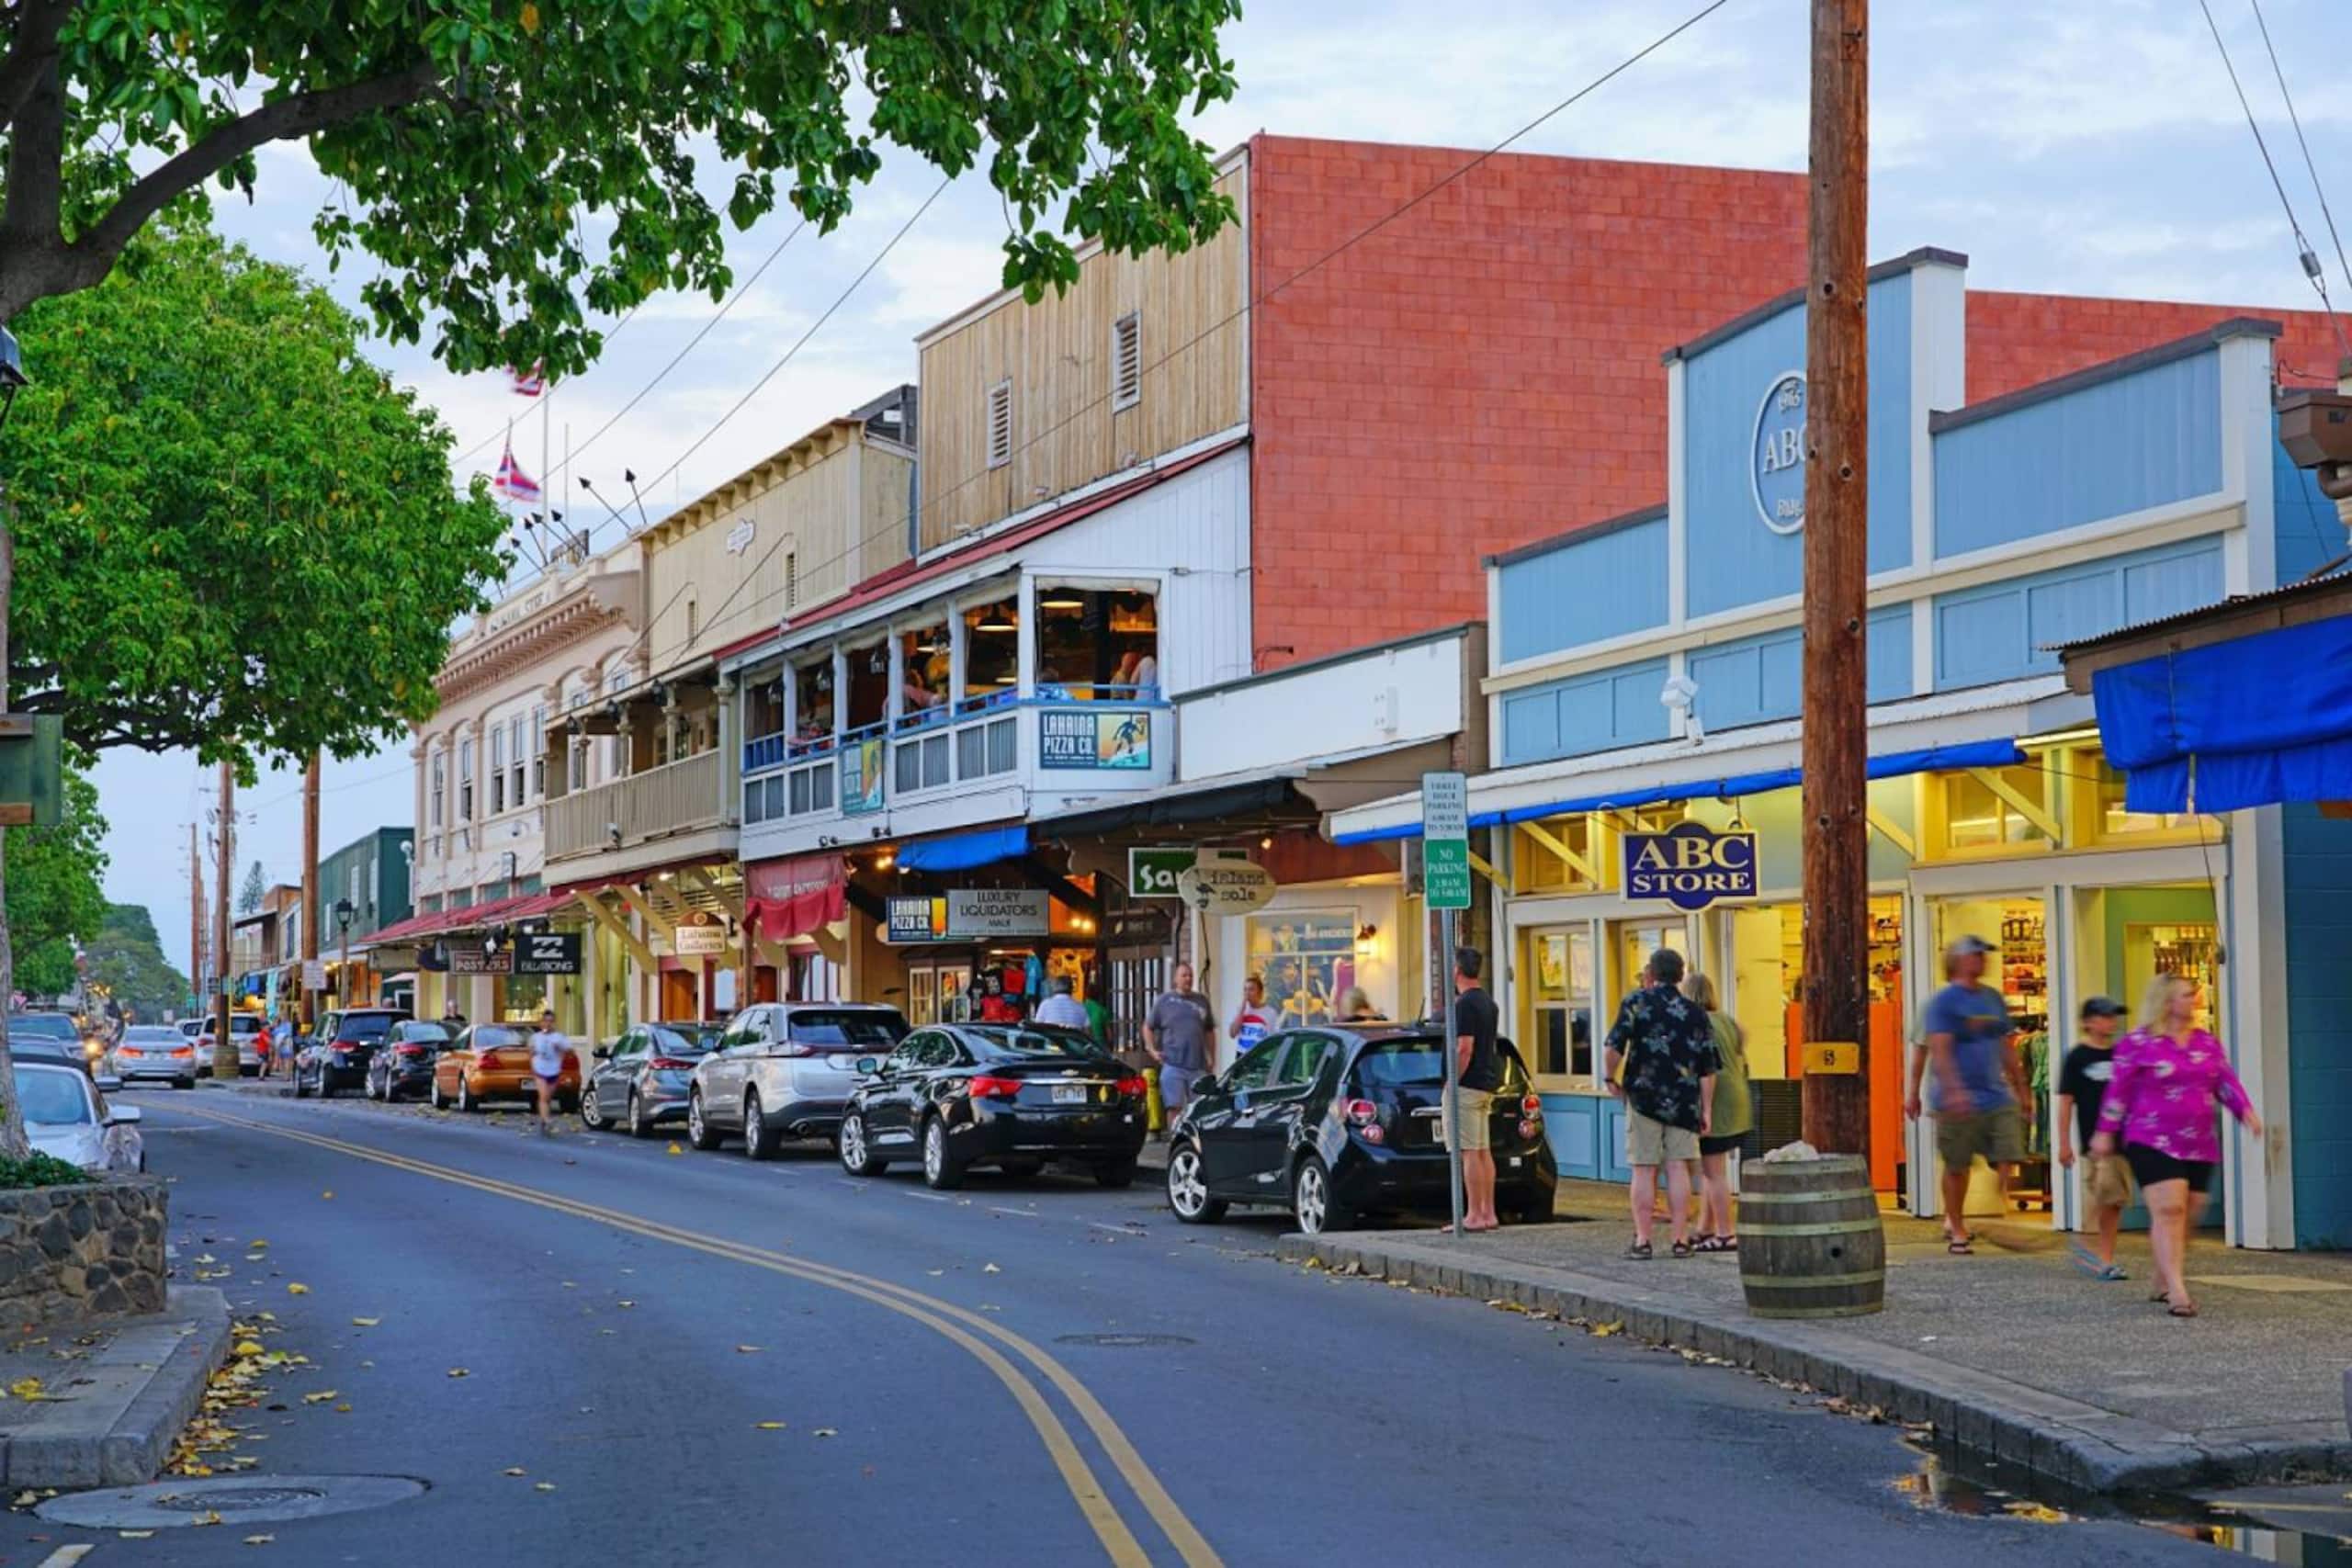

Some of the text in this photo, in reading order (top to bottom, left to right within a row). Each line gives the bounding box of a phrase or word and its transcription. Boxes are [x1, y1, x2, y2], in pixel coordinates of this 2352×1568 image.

[1044, 715, 1095, 736] LAHAINA
[1044, 737, 1095, 754] PIZZA CO.
[1427, 802, 1464, 810] PARKING
[1440, 849, 1454, 861] NO
[1632, 835, 1749, 871] ABC
[1428, 863, 1466, 874] PARKING
[1140, 864, 1180, 890] Sa
[1211, 871, 1265, 885] island
[1633, 872, 1750, 893] STORE
[977, 892, 1021, 903] LUXURY
[1220, 886, 1256, 902] sole
[890, 900, 930, 917] LAHAINA
[960, 905, 1037, 917] LIQUIDATORS
[891, 918, 915, 930] PIZZA
